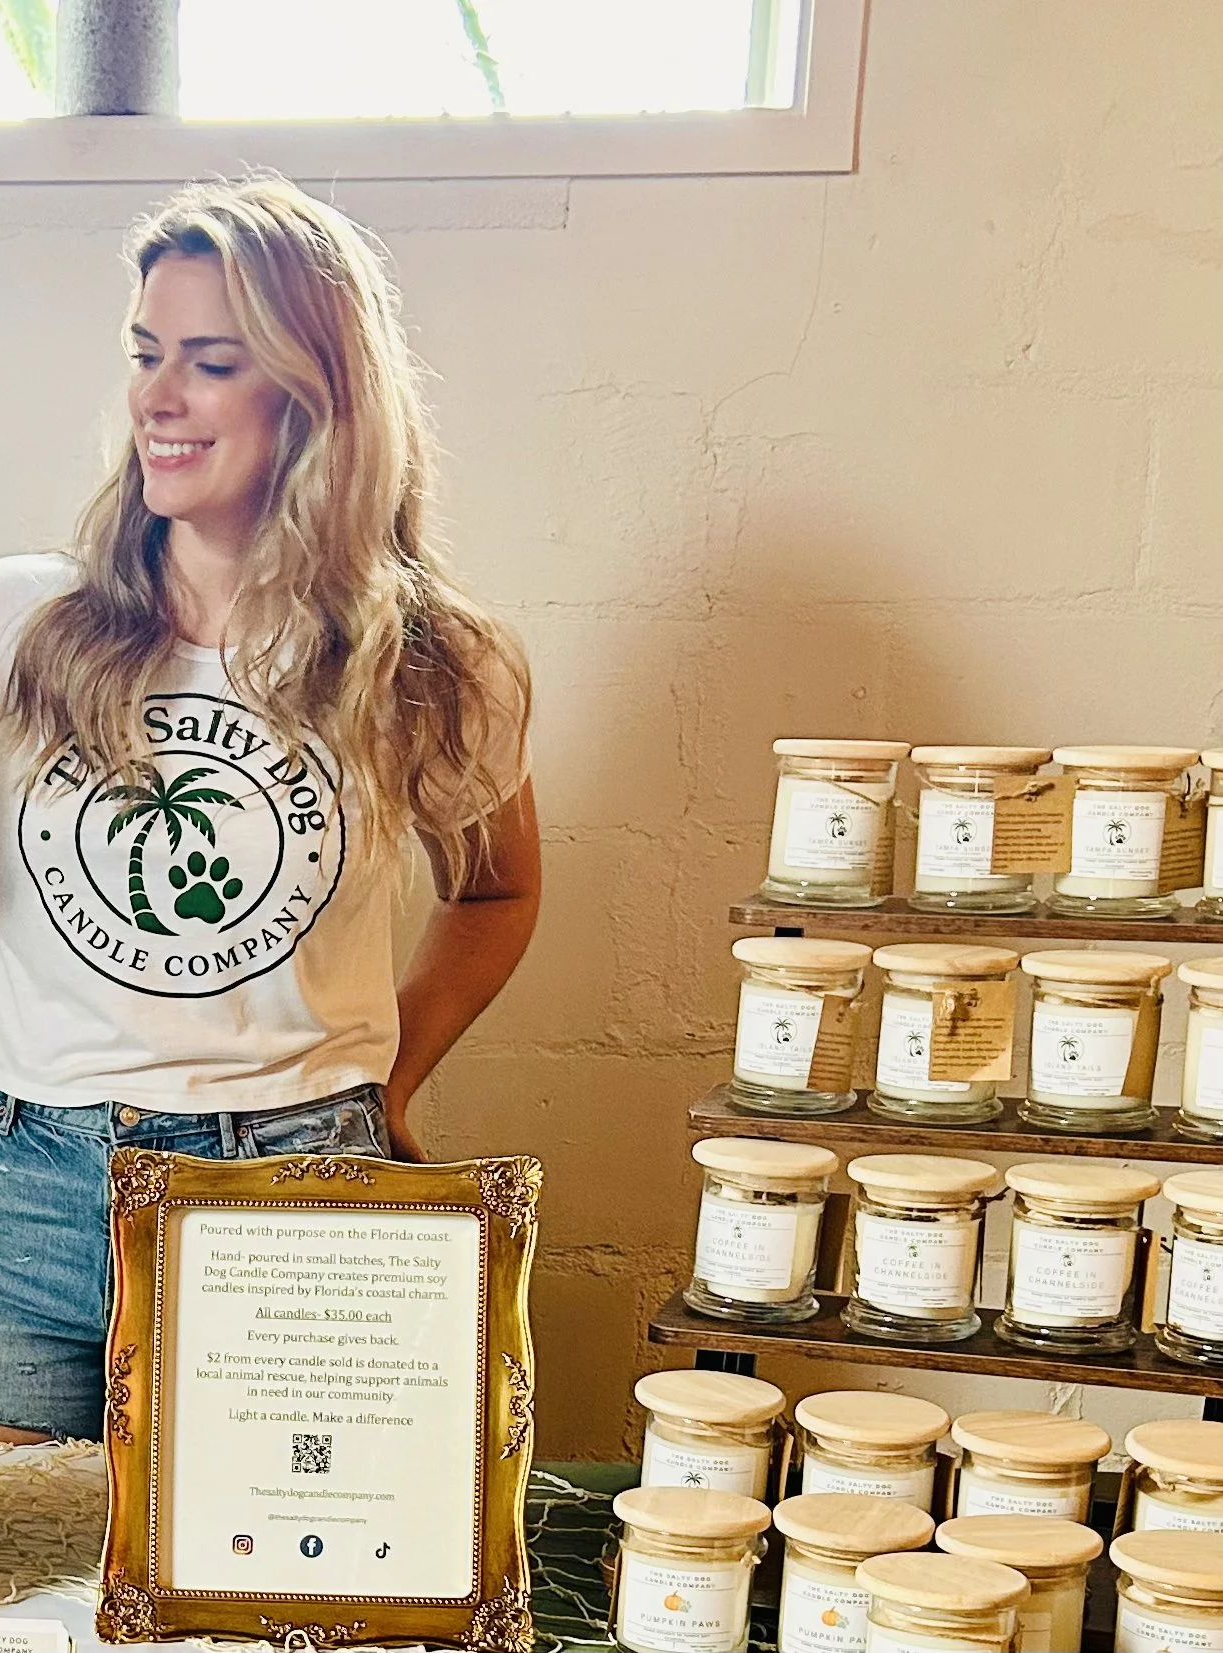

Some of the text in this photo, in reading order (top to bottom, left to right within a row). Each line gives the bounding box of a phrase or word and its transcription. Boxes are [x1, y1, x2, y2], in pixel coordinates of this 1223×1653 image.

[143, 705, 271, 761] Salty
[264, 751, 326, 835] Dog
[44, 866, 312, 977] CANDLE COMPANY
[199, 1222, 451, 1242] Poured with purpose on the Florida coast.
[210, 1249, 441, 1271] Hand- poured in small batches, The Salty
[882, 1258, 925, 1269] COFFEE
[204, 1265, 447, 1287] Dog Candle Company creates premium soy
[1036, 1266, 1079, 1279] COFFEE
[201, 1280, 244, 1294] candles
[247, 1282, 294, 1298] inspired
[296, 1281, 312, 1299] by
[314, 1284, 363, 1298] Florida's
[365, 1286, 406, 1299] coastal
[255, 1305, 271, 1318] All
[323, 1307, 363, 1321] $35.00
[365, 1309, 392, 1322] each
[247, 1329, 281, 1345] Every
[282, 1330, 335, 1346] purchase
[337, 1332, 367, 1347] gives
[206, 1351, 439, 1371] $2 from every candle sold is donated to a
[196, 1366, 448, 1388] local animal rescue, helping support animals
[246, 1385, 258, 1399] in
[260, 1385, 289, 1398] need
[291, 1386, 303, 1398] in
[304, 1389, 326, 1399] our
[228, 1407, 258, 1423] Light
[259, 1411, 267, 1421] a
[312, 1410, 344, 1424] Make
[345, 1415, 353, 1424] a
[355, 1412, 413, 1426] difference
[640, 1613, 722, 1629] PUMPKIN PAWS
[9, 1636, 29, 1645] DOG
